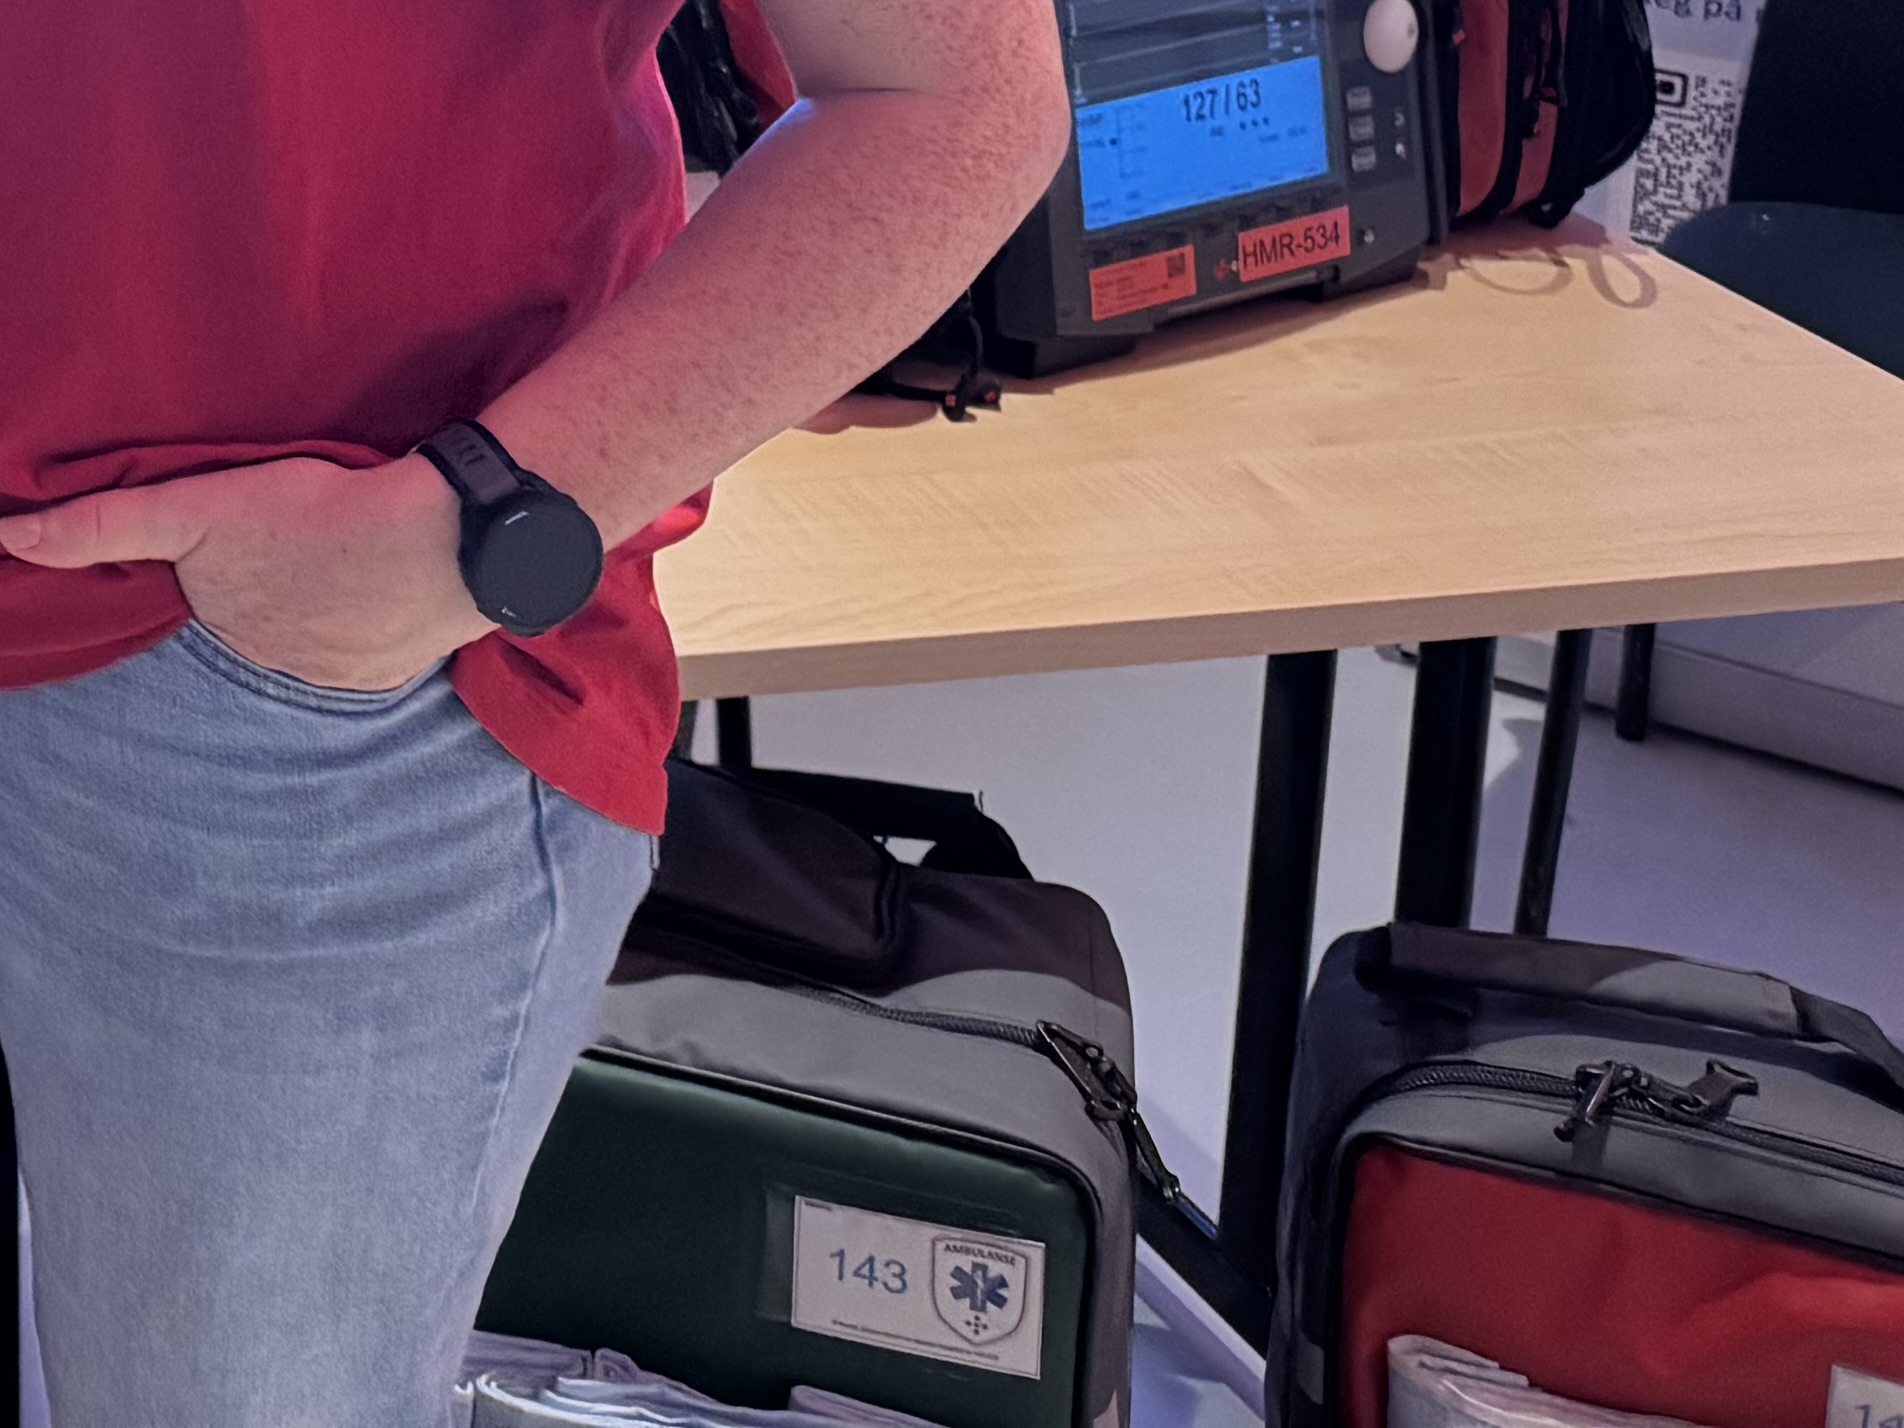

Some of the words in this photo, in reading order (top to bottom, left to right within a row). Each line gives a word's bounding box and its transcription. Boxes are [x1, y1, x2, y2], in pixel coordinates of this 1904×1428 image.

[1242, 220, 1341, 270] HMR-534
[829, 1247, 909, 1295] 143
[943, 1242, 1017, 1267] AMBULANSE
